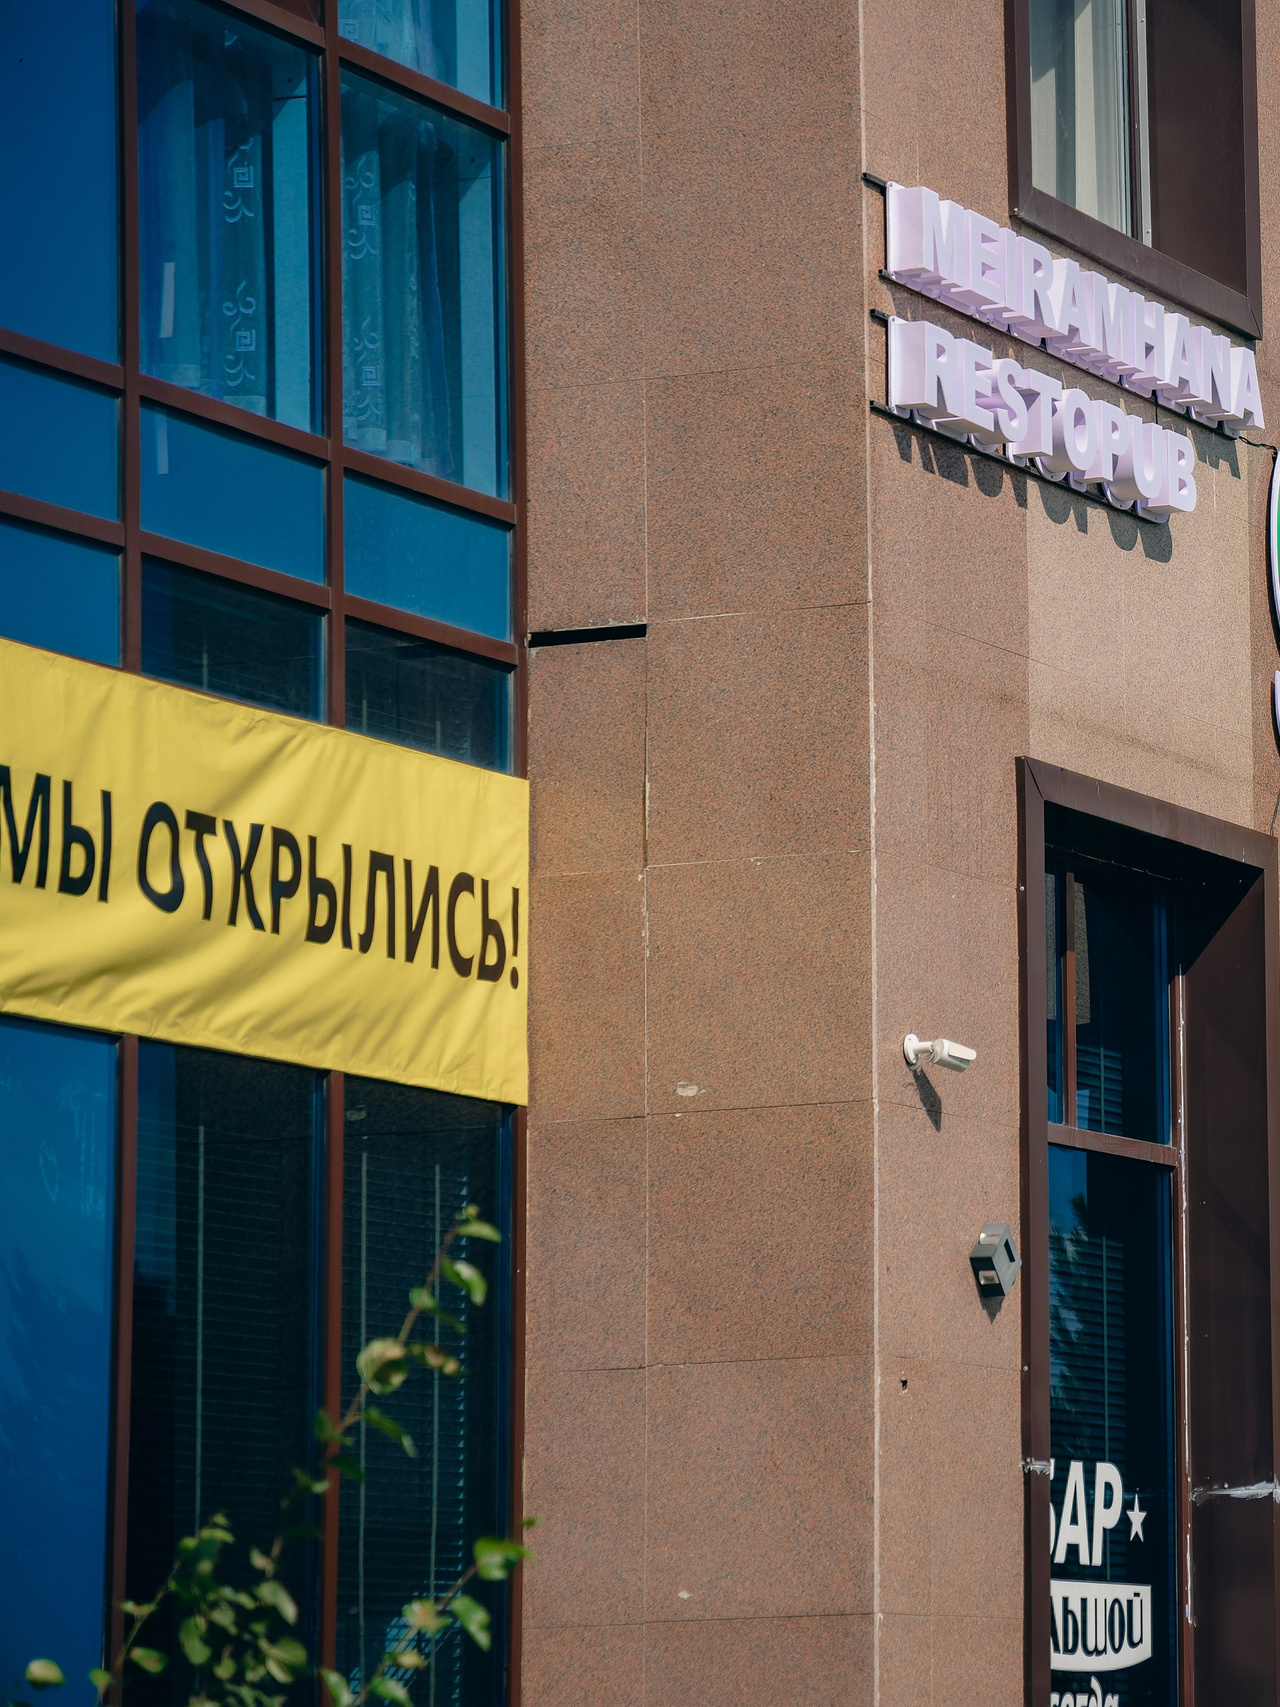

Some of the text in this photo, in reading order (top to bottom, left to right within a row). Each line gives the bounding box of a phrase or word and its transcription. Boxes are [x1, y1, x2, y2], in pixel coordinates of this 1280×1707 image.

[888, 183, 1265, 437] MEIRAMHANA
[888, 317, 1196, 520] RESTOPUB
[0, 764, 520, 990] МЫ ОТКРЫЛИСЬ!
